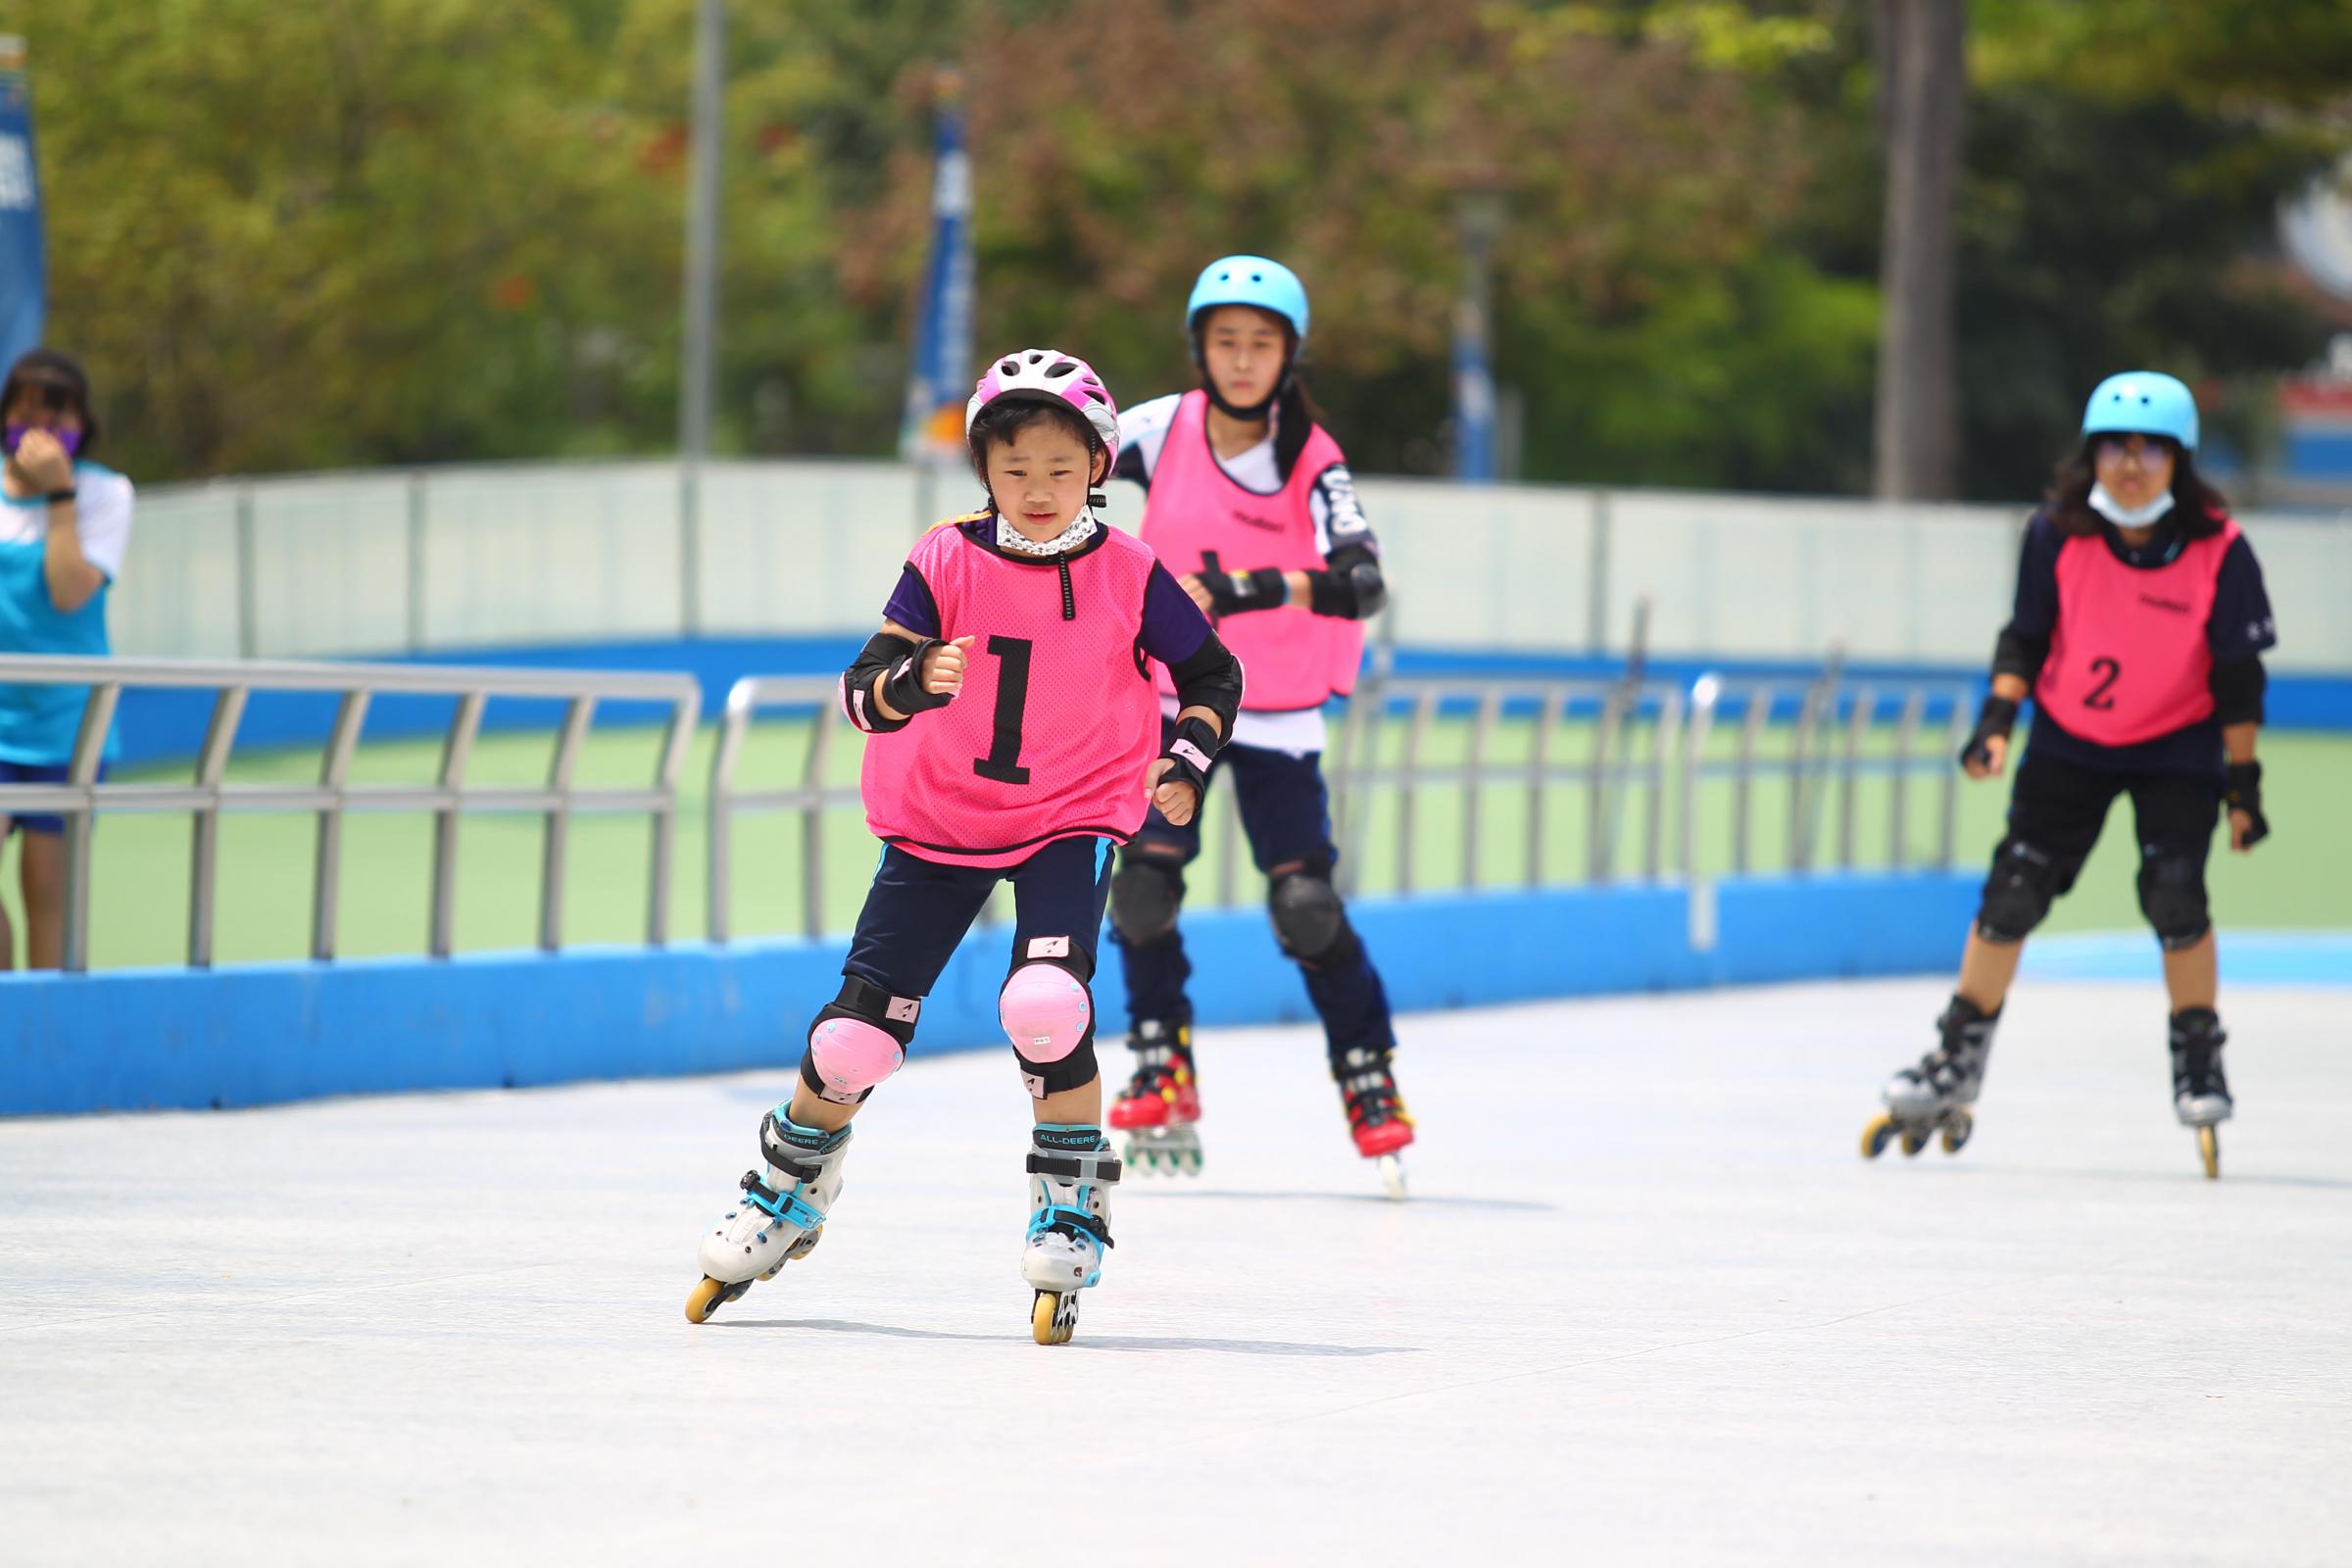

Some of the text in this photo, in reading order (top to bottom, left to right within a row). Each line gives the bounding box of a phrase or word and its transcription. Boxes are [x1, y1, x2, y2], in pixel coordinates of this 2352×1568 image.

[2082, 657, 2121, 710] 2
[974, 634, 1033, 784] 1
[784, 1134, 818, 1145] DEERE
[1040, 1134, 1096, 1145] ALL-DEERE
